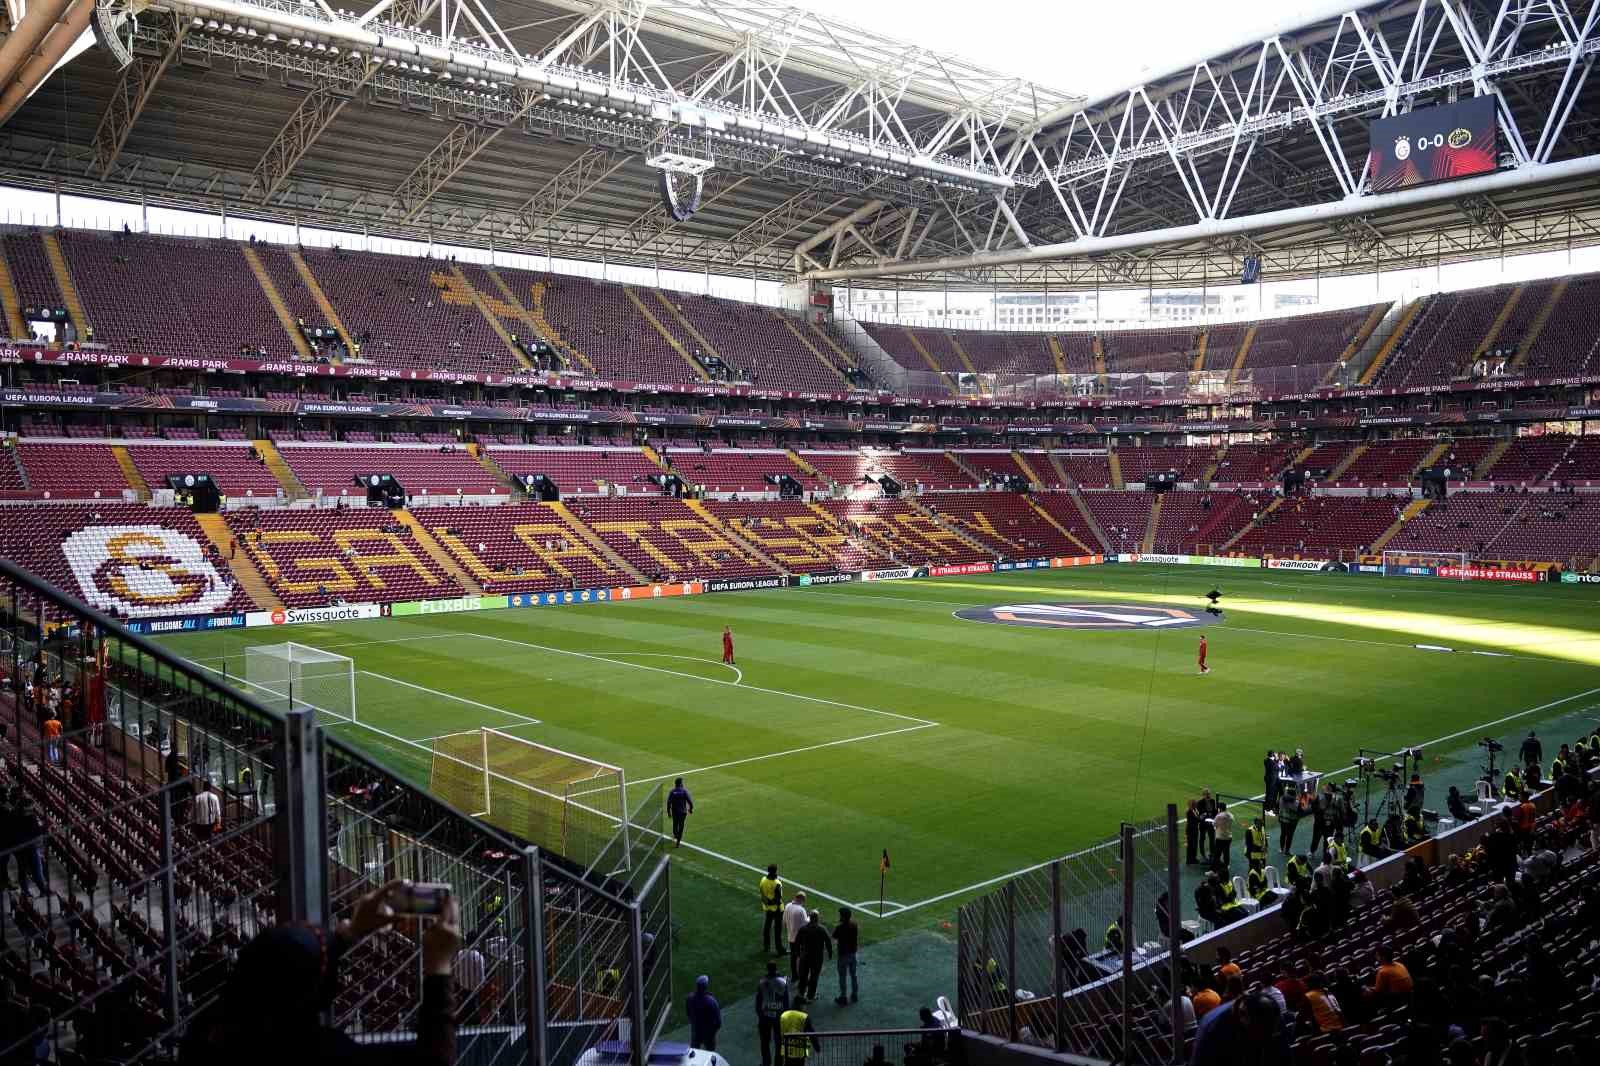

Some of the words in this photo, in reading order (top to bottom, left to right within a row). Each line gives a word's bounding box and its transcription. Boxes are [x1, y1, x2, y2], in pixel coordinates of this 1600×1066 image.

[1417, 133, 1444, 151] 0-0
[66, 353, 98, 362] RAMS
[101, 355, 129, 363] PARK
[171, 358, 200, 367] RAMS
[202, 360, 229, 370] PARK
[266, 363, 293, 372] RAMS
[294, 365, 319, 375] PARK
[353, 368, 377, 377] RAMS
[380, 369, 401, 377] PARK
[433, 372, 456, 381] RAMS
[457, 374, 478, 382] PARK
[506, 376, 527, 384] RAMS
[530, 378, 548, 386] PARK
[1480, 382, 1503, 390] RAMS
[1555, 377, 1580, 385] RAMS
[696, 386, 714, 394] RAMS
[715, 387, 730, 395] PARK
[752, 389, 767, 397] RAMS
[63, 396, 93, 404] LEAGUE
[1140, 554, 1179, 564] Swissquote
[801, 573, 852, 586] enterprise
[1496, 571, 1533, 580] STRAUSS
[712, 583, 728, 591] UEFA
[730, 581, 755, 590] EUROPA
[756, 579, 779, 588] LEAGUE
[287, 608, 359, 623] Swissquote
